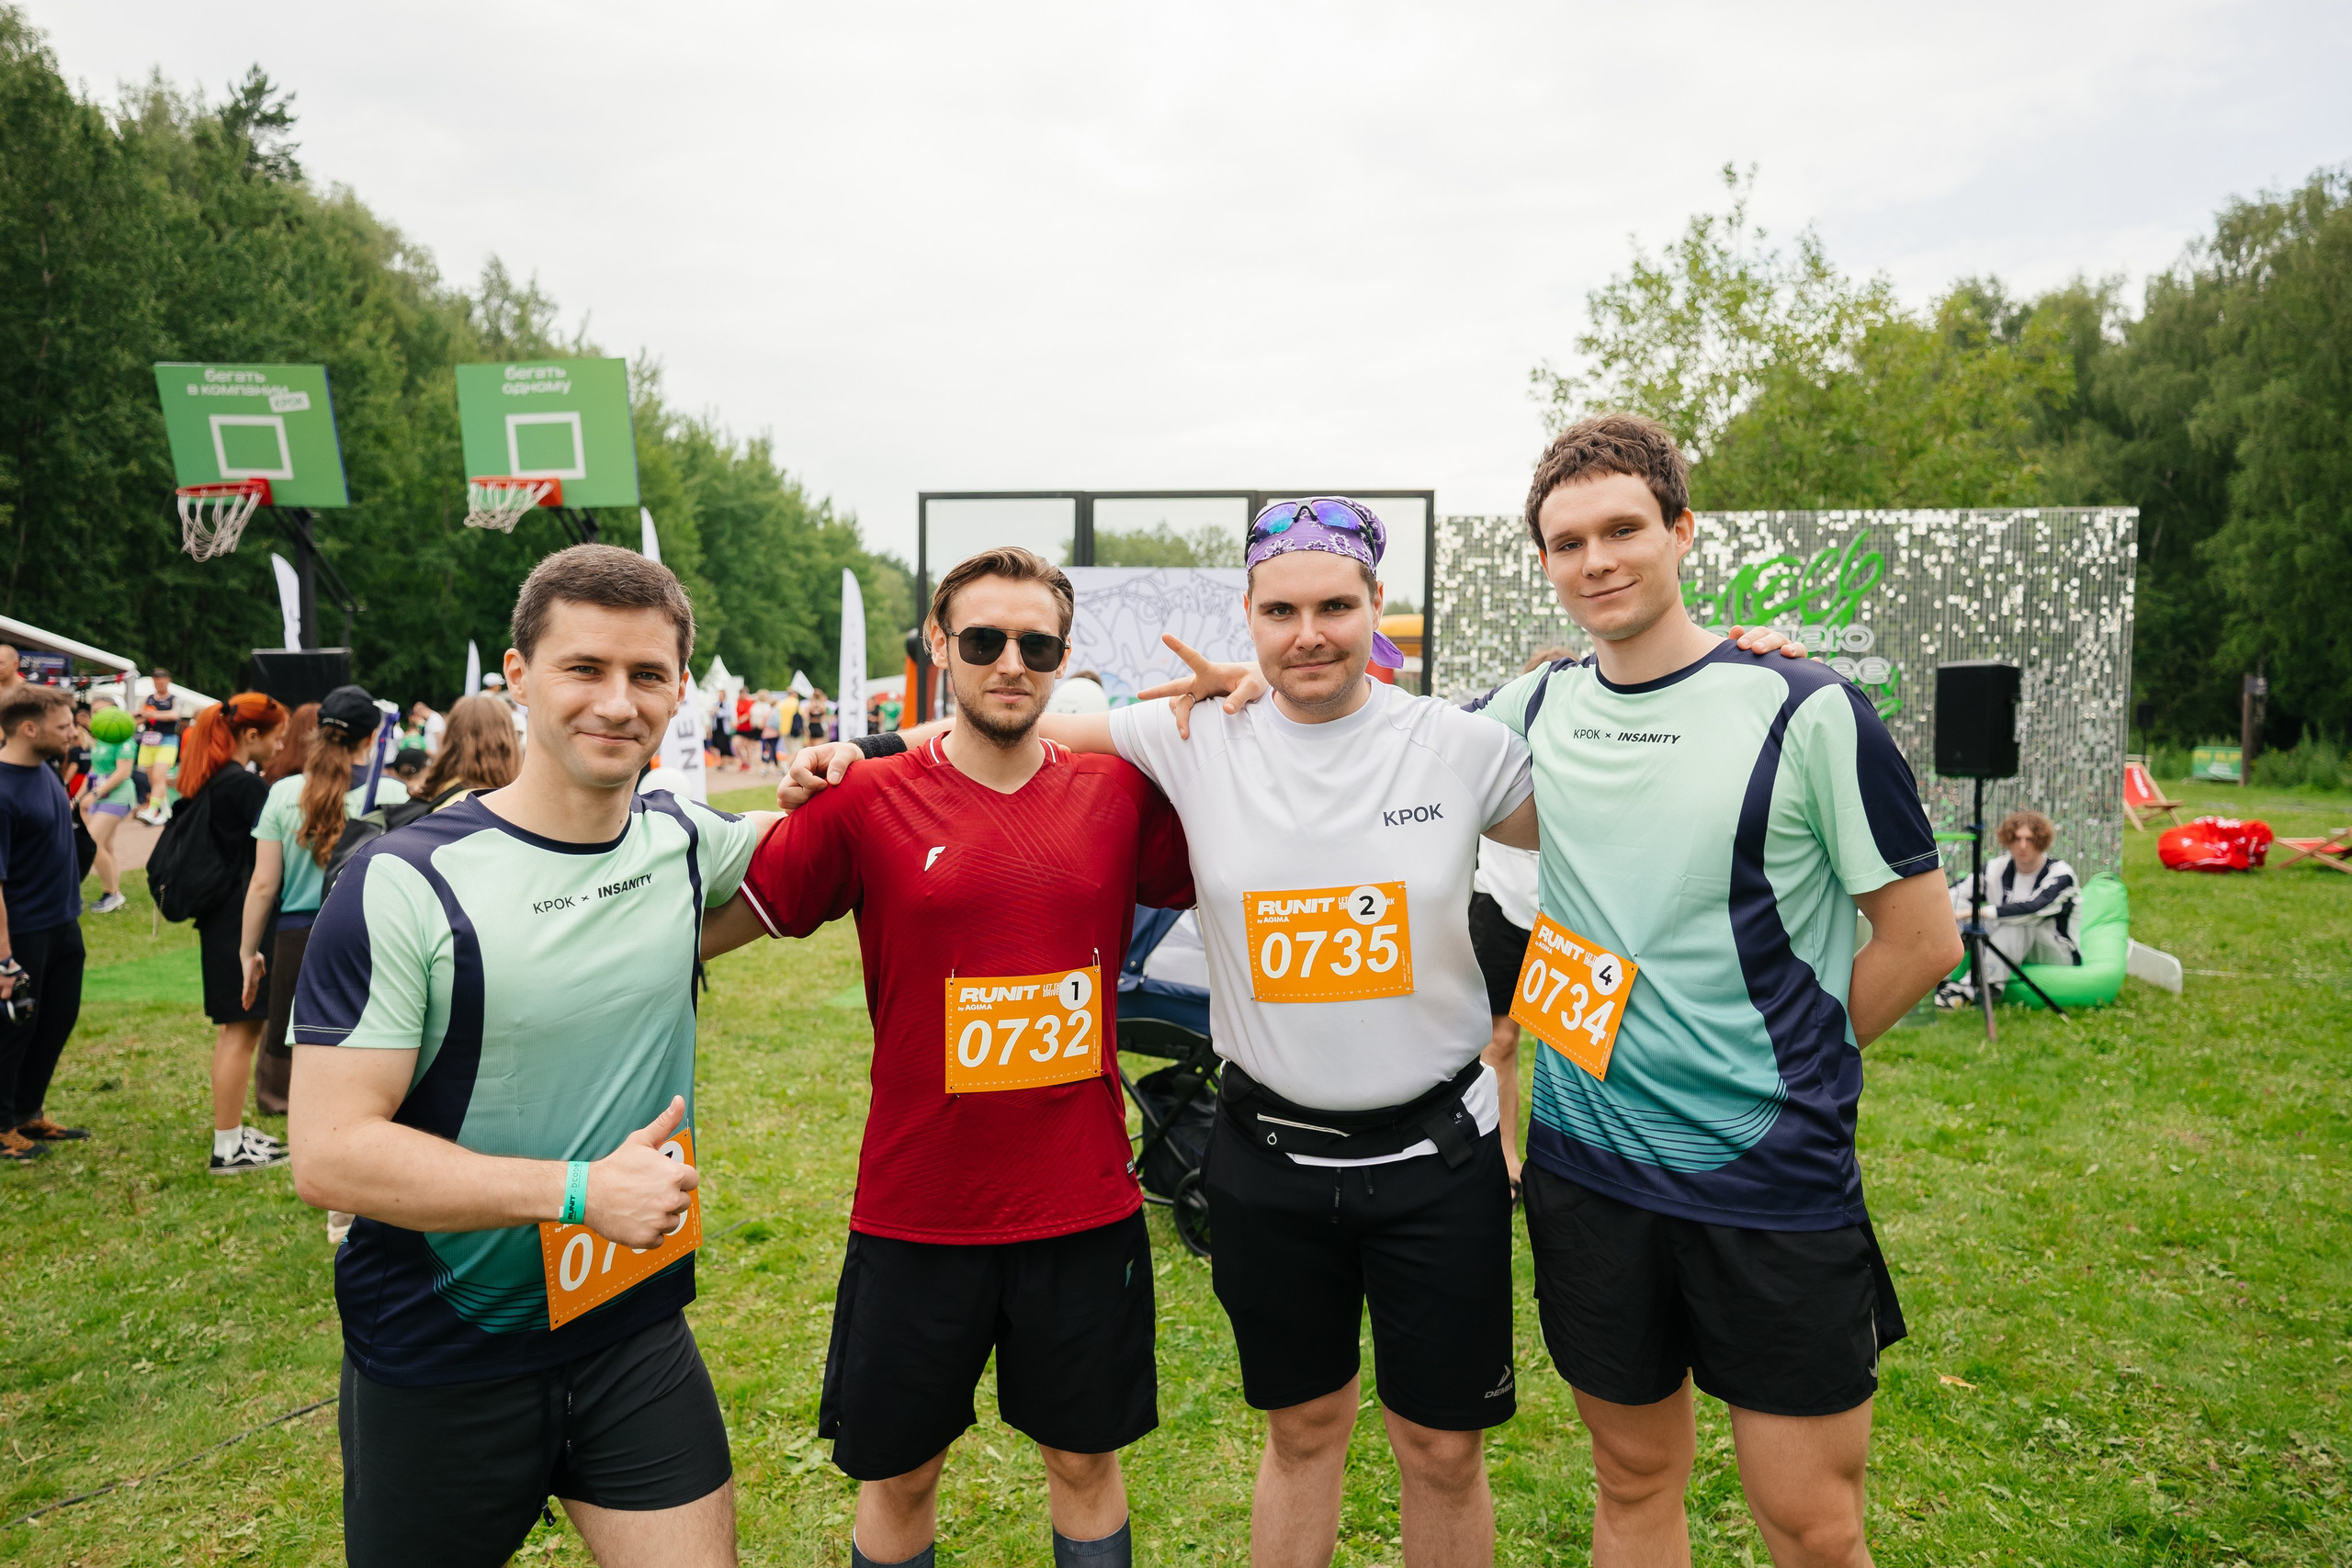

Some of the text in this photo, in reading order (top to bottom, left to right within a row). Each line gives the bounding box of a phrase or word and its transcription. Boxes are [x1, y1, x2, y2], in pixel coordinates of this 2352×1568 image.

[204, 368, 267, 383] бегать
[503, 365, 567, 381] бегать
[187, 383, 290, 397] в компании
[502, 379, 572, 396] одному
[1617, 732, 1680, 744] INSANITY
[1383, 803, 1444, 827] КРОК
[597, 873, 652, 898] INSANITY
[1258, 897, 1335, 916] RUNIT
[1359, 896, 1375, 916] 2
[1261, 924, 1398, 979] 0735
[1537, 924, 1585, 962] RUNIT
[1599, 964, 1612, 987] 4
[959, 985, 1040, 1003] RUNIT
[1071, 981, 1080, 1000] 1
[1522, 958, 1616, 1047] 0734
[957, 1010, 1092, 1067] 0732
[1484, 1381, 1514, 1399] DEMIX
